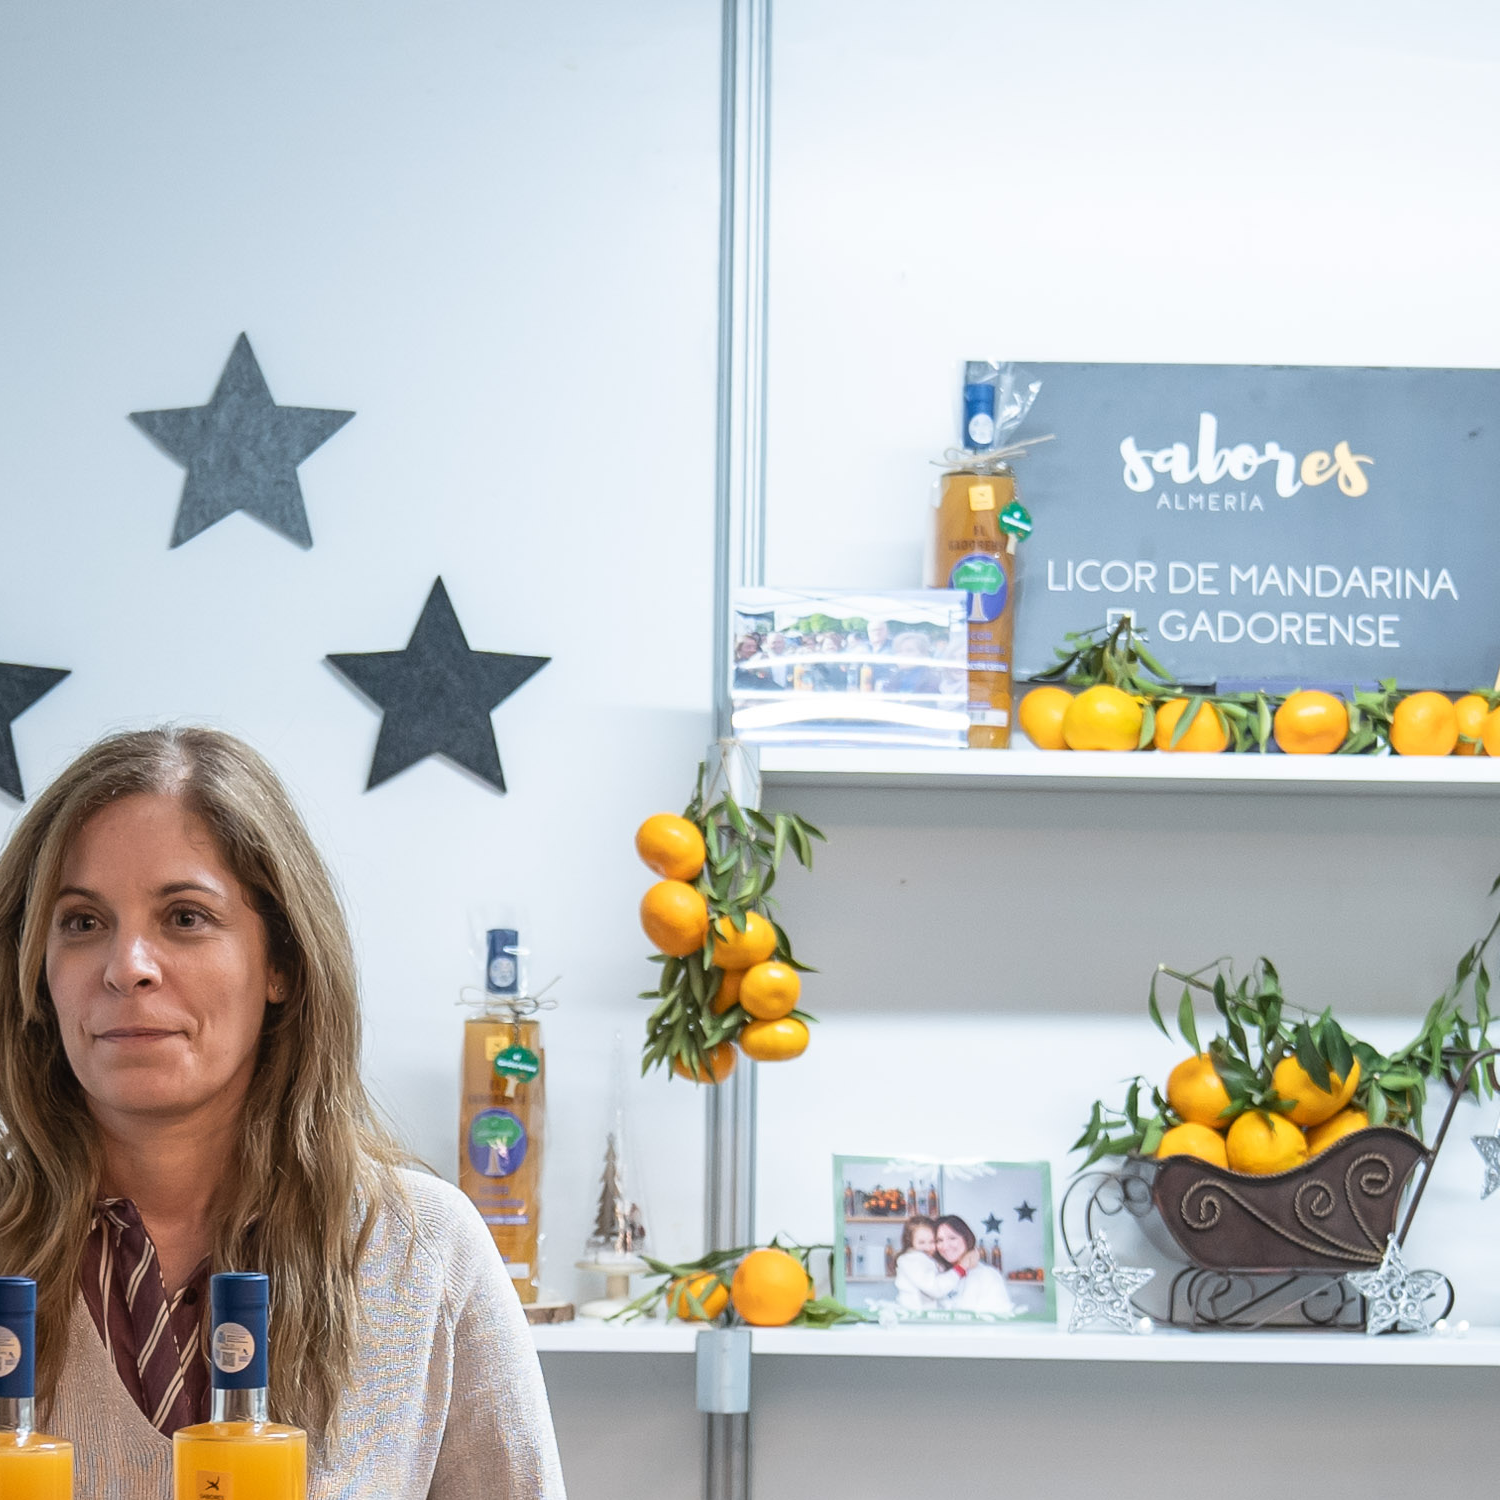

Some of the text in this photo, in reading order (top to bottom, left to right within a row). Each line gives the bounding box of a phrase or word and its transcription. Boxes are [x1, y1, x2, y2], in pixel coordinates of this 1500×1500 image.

[1119, 411, 1374, 498] sabores
[1047, 559, 1460, 601] LICOR DE MANDARINA
[1158, 609, 1401, 648] GADORENSE
